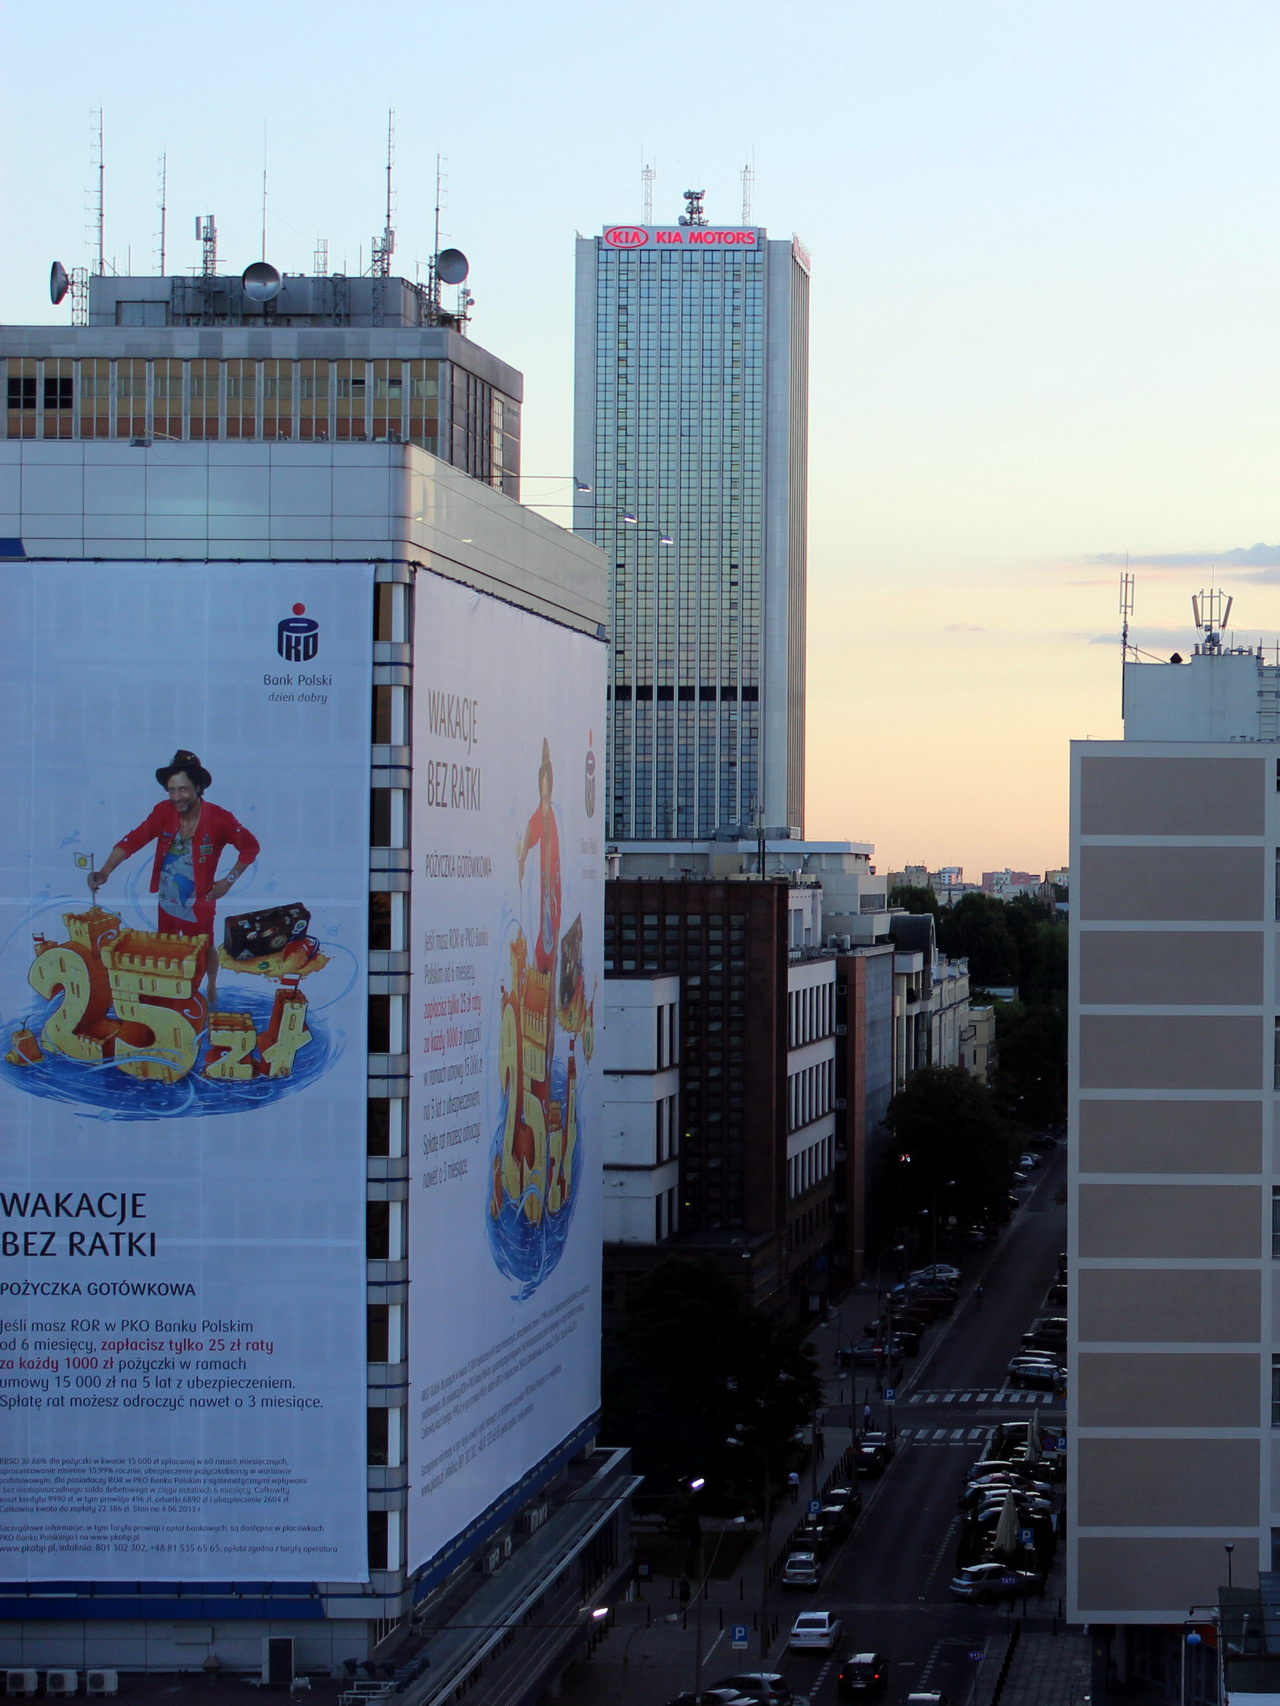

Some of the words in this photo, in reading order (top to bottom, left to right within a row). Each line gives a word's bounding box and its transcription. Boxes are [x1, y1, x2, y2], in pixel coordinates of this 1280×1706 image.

[612, 231, 642, 244] KIA
[656, 231, 683, 244] KIA
[689, 231, 756, 245] MOTORS
[263, 674, 294, 686] Bank
[298, 674, 332, 686] Polski
[268, 692, 295, 702] dzień
[298, 692, 328, 705] dobry
[428, 688, 478, 755] WAKACJE
[427, 760, 448, 807] BEZ
[451, 766, 481, 811] RATKI
[28, 930, 207, 1084] 25
[204, 990, 313, 1080] zł
[0, 1192, 147, 1226] WAKACJE
[2, 1231, 57, 1257] BEZ
[69, 1231, 157, 1257] RATKI
[0, 1280, 82, 1296] POŻYCZKA
[87, 1280, 196, 1296] GOTÓWKOWA
[0, 1319, 26, 1334] Jeśli
[31, 1322, 66, 1332] masz
[71, 1319, 100, 1332] ROR
[105, 1322, 116, 1332] w
[121, 1319, 149, 1332] PKO
[155, 1319, 196, 1332] Banku
[202, 1319, 253, 1332] Polskim
[0, 1338, 16, 1351] od
[21, 1338, 29, 1351] 6
[34, 1338, 97, 1354] miesięcy,
[101, 1338, 164, 1354] zapłacisz
[169, 1338, 203, 1354] tylko
[209, 1338, 225, 1351] 25
[230, 1338, 241, 1351] zł
[246, 1338, 274, 1354] raty
[0, 1360, 14, 1369] za
[19, 1357, 59, 1373] każdy
[65, 1357, 98, 1369] 1000
[103, 1357, 114, 1369] zł
[119, 1357, 175, 1373] pożyczki
[180, 1360, 191, 1369] w
[196, 1357, 246, 1369] ramach
[0, 1379, 49, 1391] umowy
[55, 1376, 71, 1388] 15
[75, 1376, 101, 1388] 000
[106, 1376, 116, 1388] zł
[121, 1379, 137, 1388] na
[143, 1376, 150, 1388] 5
[155, 1376, 172, 1388] lat
[177, 1379, 182, 1388] z
[187, 1376, 295, 1391] ubezpieczeniem.
[0, 1395, 42, 1411] Spłatę
[47, 1395, 65, 1407] rat
[70, 1395, 119, 1407] możesz
[123, 1395, 184, 1411] odroczyć
[190, 1395, 230, 1407] nawet
[235, 1398, 243, 1407] o
[248, 1395, 256, 1407] 3
[261, 1395, 323, 1411] miesiące.
[1022, 1530, 1031, 1541] P
[735, 1627, 745, 1640] P
